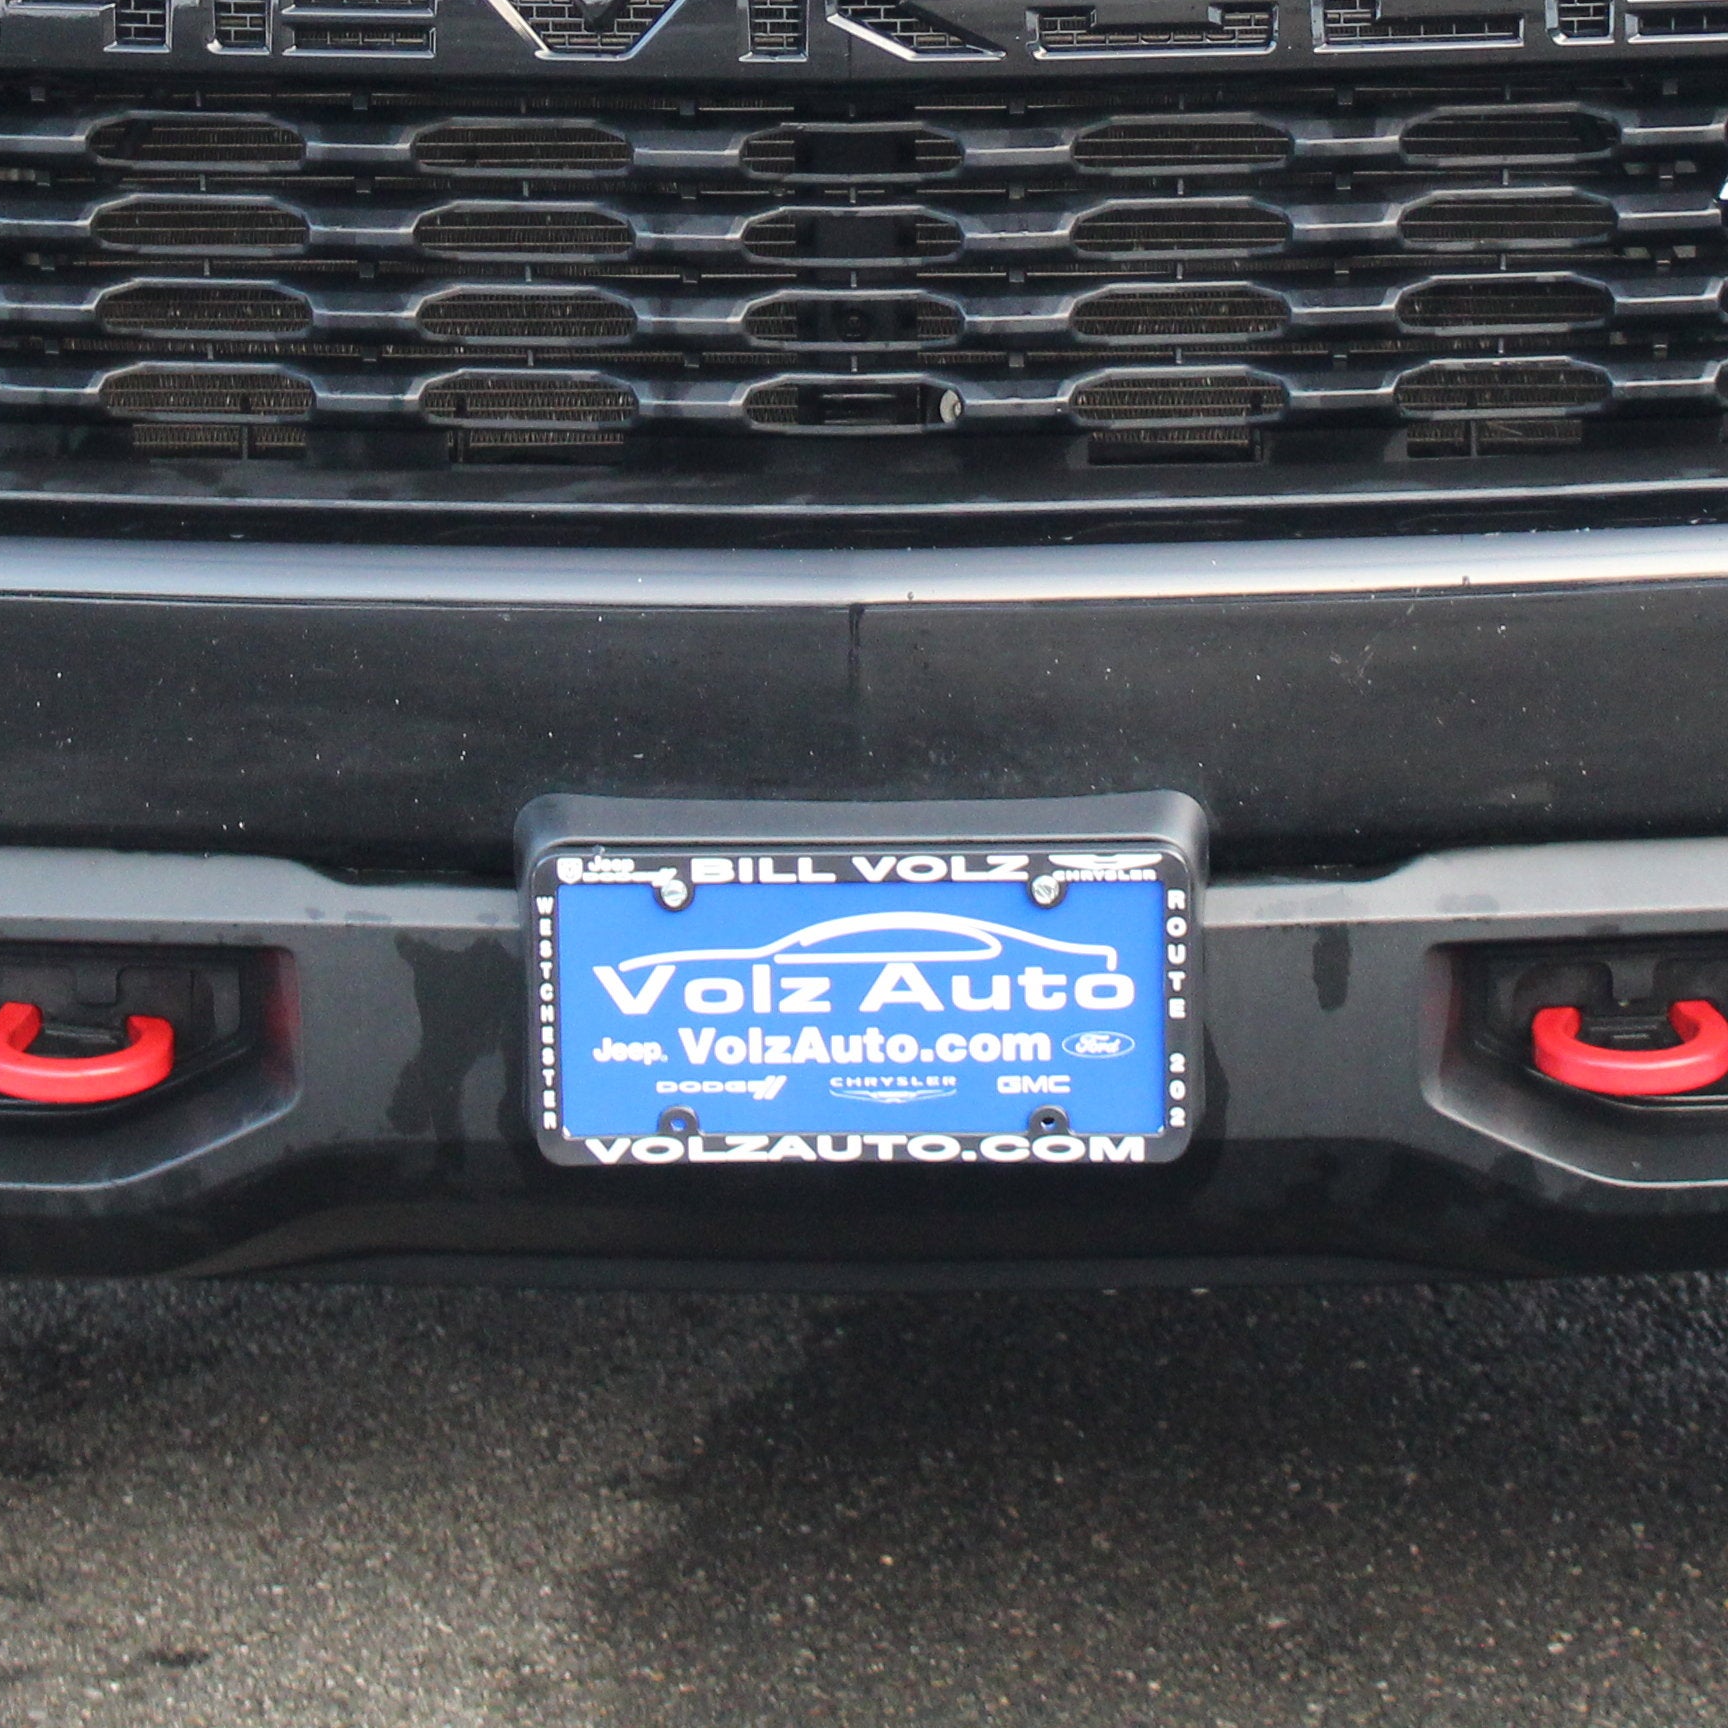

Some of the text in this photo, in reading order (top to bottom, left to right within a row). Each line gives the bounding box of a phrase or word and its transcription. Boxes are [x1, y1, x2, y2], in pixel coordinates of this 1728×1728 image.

[690, 857, 837, 884] BILL
[851, 855, 1030, 883] VOLZ
[1052, 869, 1157, 882] CHRYSLER
[593, 963, 1136, 1015] Volz Auto
[536, 896, 558, 1131] WESTCHESTER
[1166, 889, 1188, 1128] ROUTE 202
[592, 1037, 663, 1066] Jeep
[677, 1026, 1052, 1065] VolzAuto.com
[829, 1075, 957, 1088] CHRYSLER
[997, 1075, 1071, 1094] GMC
[586, 1133, 1146, 1164] VOLZAUTO.COM
